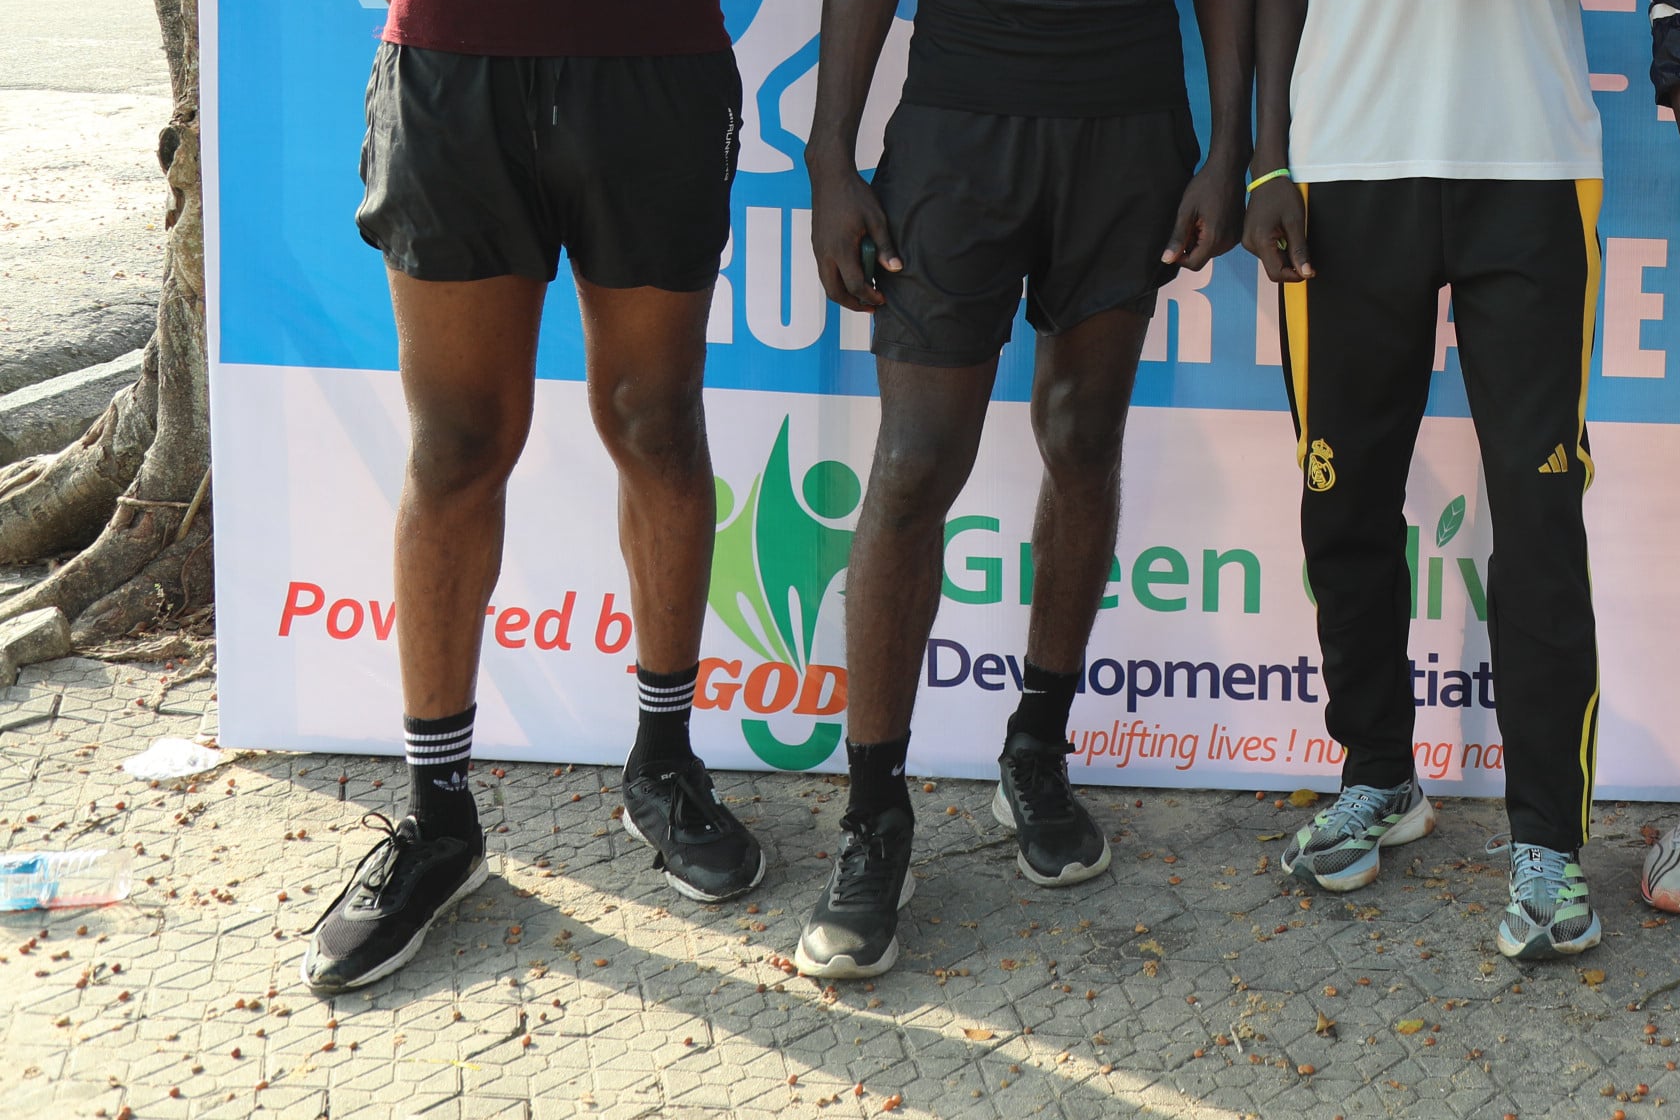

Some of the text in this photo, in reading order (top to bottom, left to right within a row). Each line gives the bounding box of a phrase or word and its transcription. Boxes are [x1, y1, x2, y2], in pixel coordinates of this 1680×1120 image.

[278, 582, 576, 651] Poed
[927, 639, 1318, 713] Delopment
[1208, 723, 1278, 762] lives
